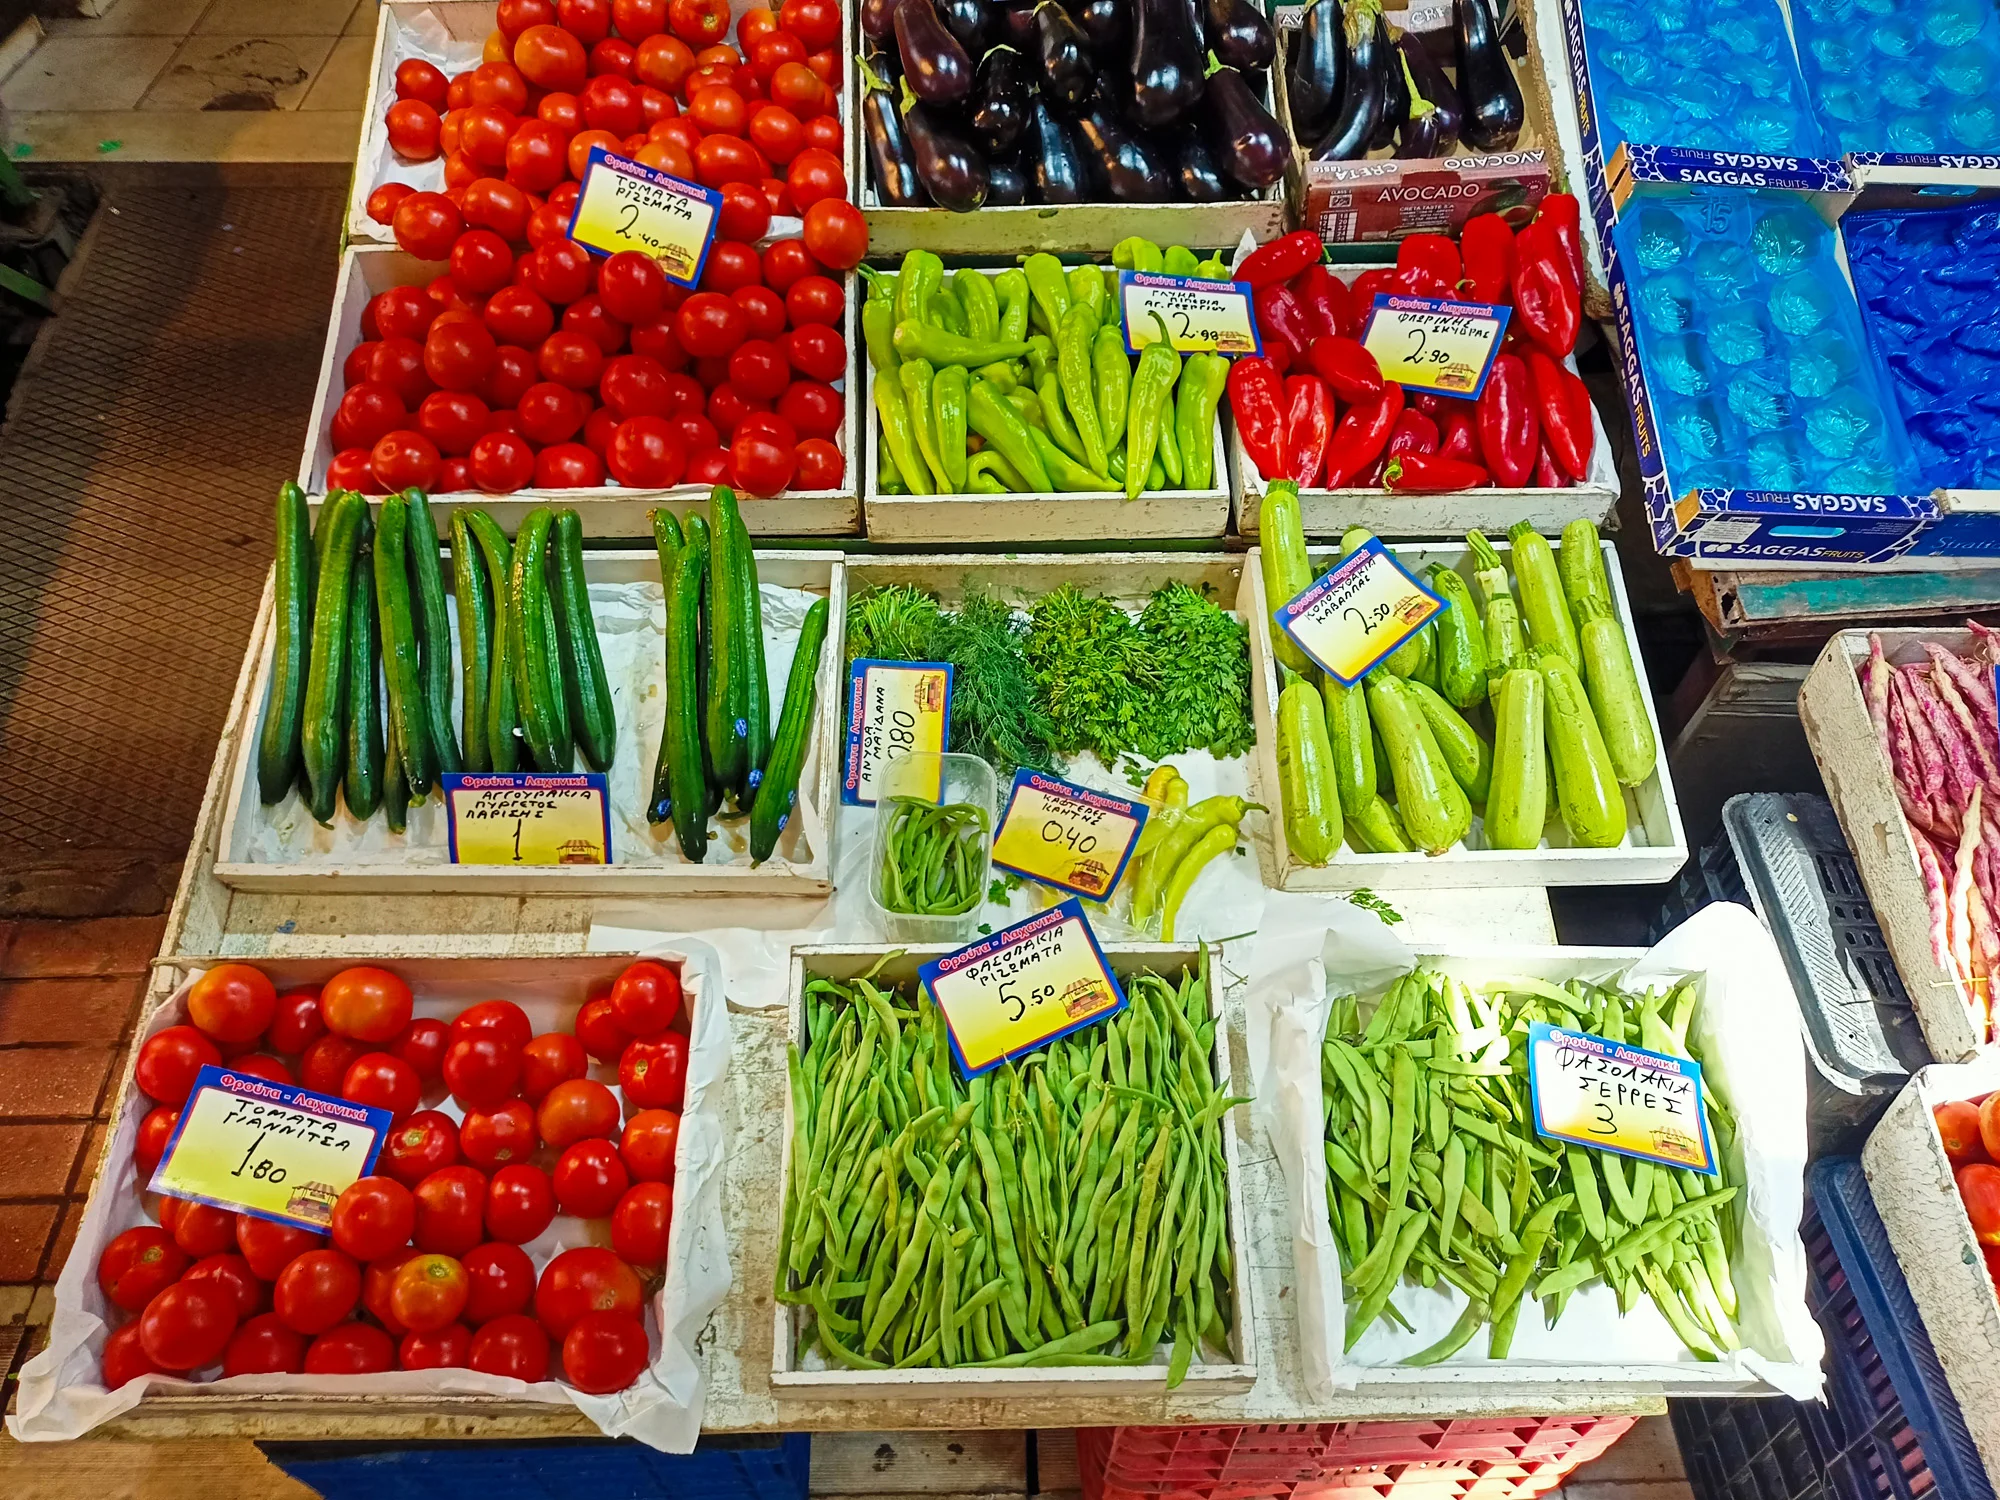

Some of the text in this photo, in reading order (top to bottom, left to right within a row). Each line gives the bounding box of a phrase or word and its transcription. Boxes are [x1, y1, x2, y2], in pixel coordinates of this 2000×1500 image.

[1568, 12, 1591, 138] SAGGAS FRUITS
[1335, 163, 1398, 181] CRETA
[1444, 150, 1546, 169] AVOCADO
[1670, 148, 1799, 171] SAGGAS FRUITS
[1895, 155, 2000, 169] GGAS FRUITS
[604, 153, 647, 178] Φρούτα
[654, 172, 708, 200] Λαχανικά
[616, 174, 688, 207] ΤΟΜΑΤΑ
[1680, 168, 1809, 189] SAGGAS FRUITS
[1377, 184, 1480, 203] AVOCADO
[1134, 274, 1176, 286] Φρούτα
[1185, 279, 1235, 291] Λαχανικά
[1389, 297, 1431, 309] Φρούτα
[1438, 302, 1493, 316] Λαχανικά
[1618, 308, 1651, 458] SAGGAS FRUITS
[1746, 492, 1887, 513] SAGGAS FRUITS
[1733, 545, 1826, 557] SAGGAS
[1288, 585, 1324, 615] Φρούτα
[1328, 548, 1371, 583] Λαχανικά
[850, 677, 863, 734] Λαχανικά
[462, 776, 513, 788] Φρούτα
[525, 776, 588, 788] Λαχανικά
[846, 744, 859, 789] Φρούτα
[475, 801, 557, 809] ΠΥΡΓΕΤΟΣ
[482, 790, 591, 800] ΑΓΓΟΥΡΑΚΙΑ
[1031, 774, 1071, 795] Φρούτα
[1080, 791, 1132, 813] Λαχανικά
[938, 942, 990, 971] Φρούτα
[1001, 909, 1063, 946] Λαχανικά
[1549, 1029, 1604, 1053] Φρούτα
[1615, 1047, 1681, 1072] Λαχανικά
[1555, 1042, 1693, 1095] ΦΑΣΟΛΑΚΙΑ
[220, 1074, 281, 1100] Φρούτα
[292, 1093, 369, 1121] Λαχανικά
[1579, 1076, 1682, 1115] ΣΕΡΡΕΣ
[236, 1099, 338, 1133] ΤΟΜΑΤΑ
